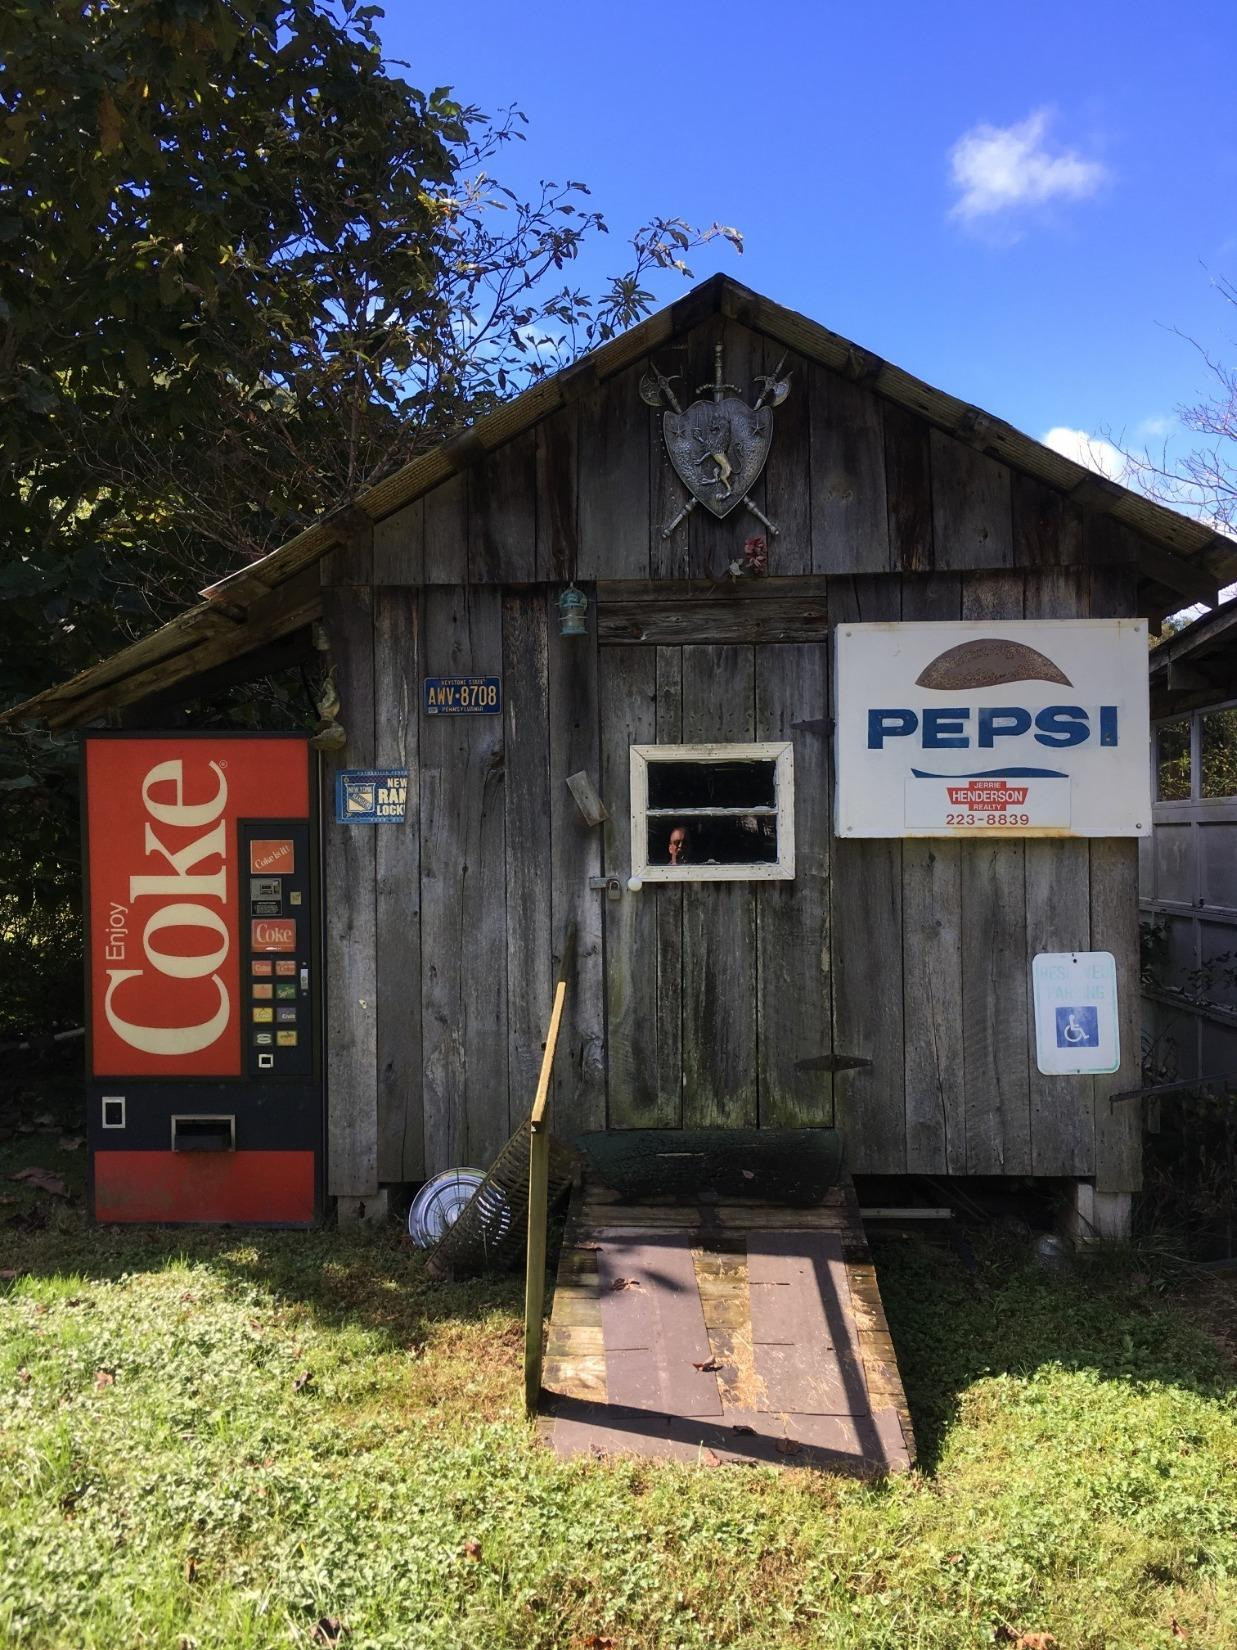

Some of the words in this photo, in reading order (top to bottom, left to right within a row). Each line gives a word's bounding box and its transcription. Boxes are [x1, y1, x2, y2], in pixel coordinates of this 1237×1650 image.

[868, 705, 1118, 749] PEPSI
[952, 790, 1023, 802] HENDERSON
[945, 813, 1029, 825] 223-8839
[105, 759, 230, 1056] Coke
[105, 901, 128, 960] Enjoy
[256, 923, 292, 943] Coke
